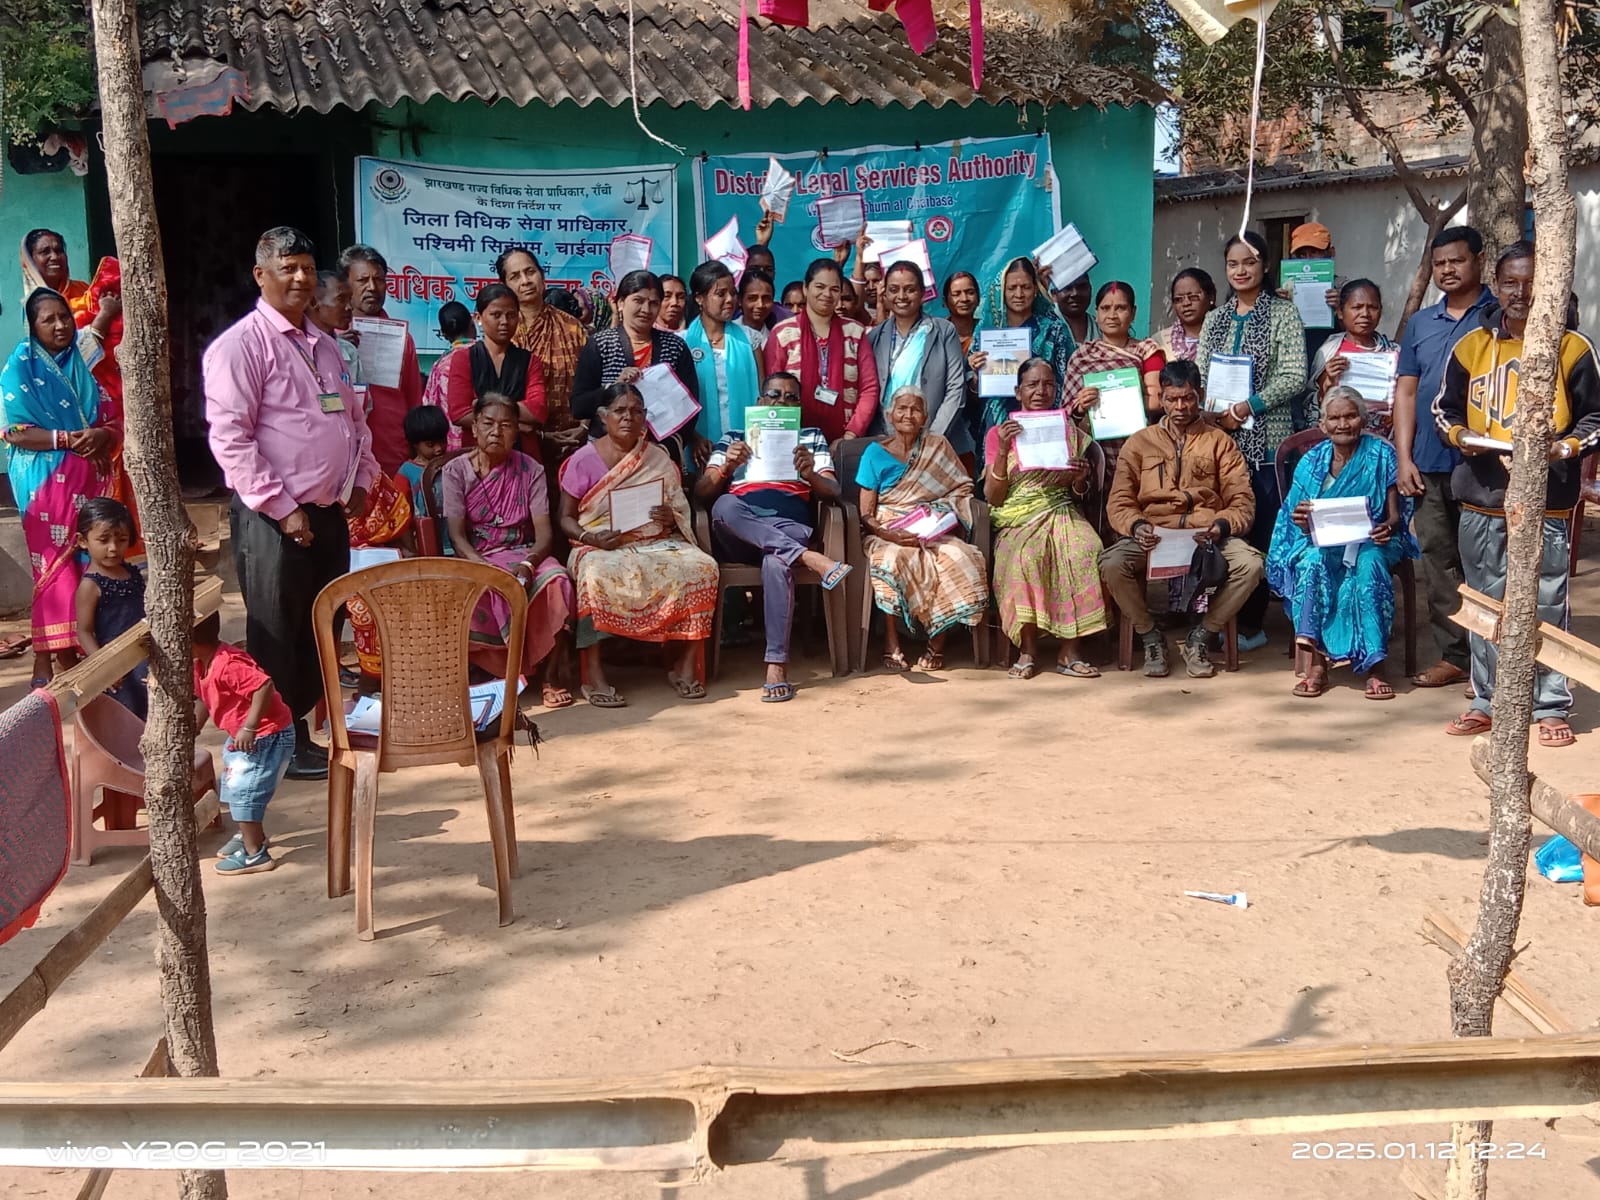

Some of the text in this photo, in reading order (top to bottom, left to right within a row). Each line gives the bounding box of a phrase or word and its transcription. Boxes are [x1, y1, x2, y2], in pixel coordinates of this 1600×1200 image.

[796, 166, 850, 198] Legal
[855, 162, 942, 191] Services
[947, 148, 1037, 184] Authority
[467, 183, 488, 194] राज्य
[490, 183, 522, 196] विधिक
[524, 184, 545, 197] सेवा
[476, 195, 488, 207] के
[490, 197, 515, 210] दिशा
[548, 202, 563, 212] पर
[894, 199, 904, 212] at
[907, 194, 954, 210] Chaibasa
[403, 207, 633, 234] जिला विधिक सेवा प्राधिकार,
[413, 233, 476, 253] पश्चिमी
